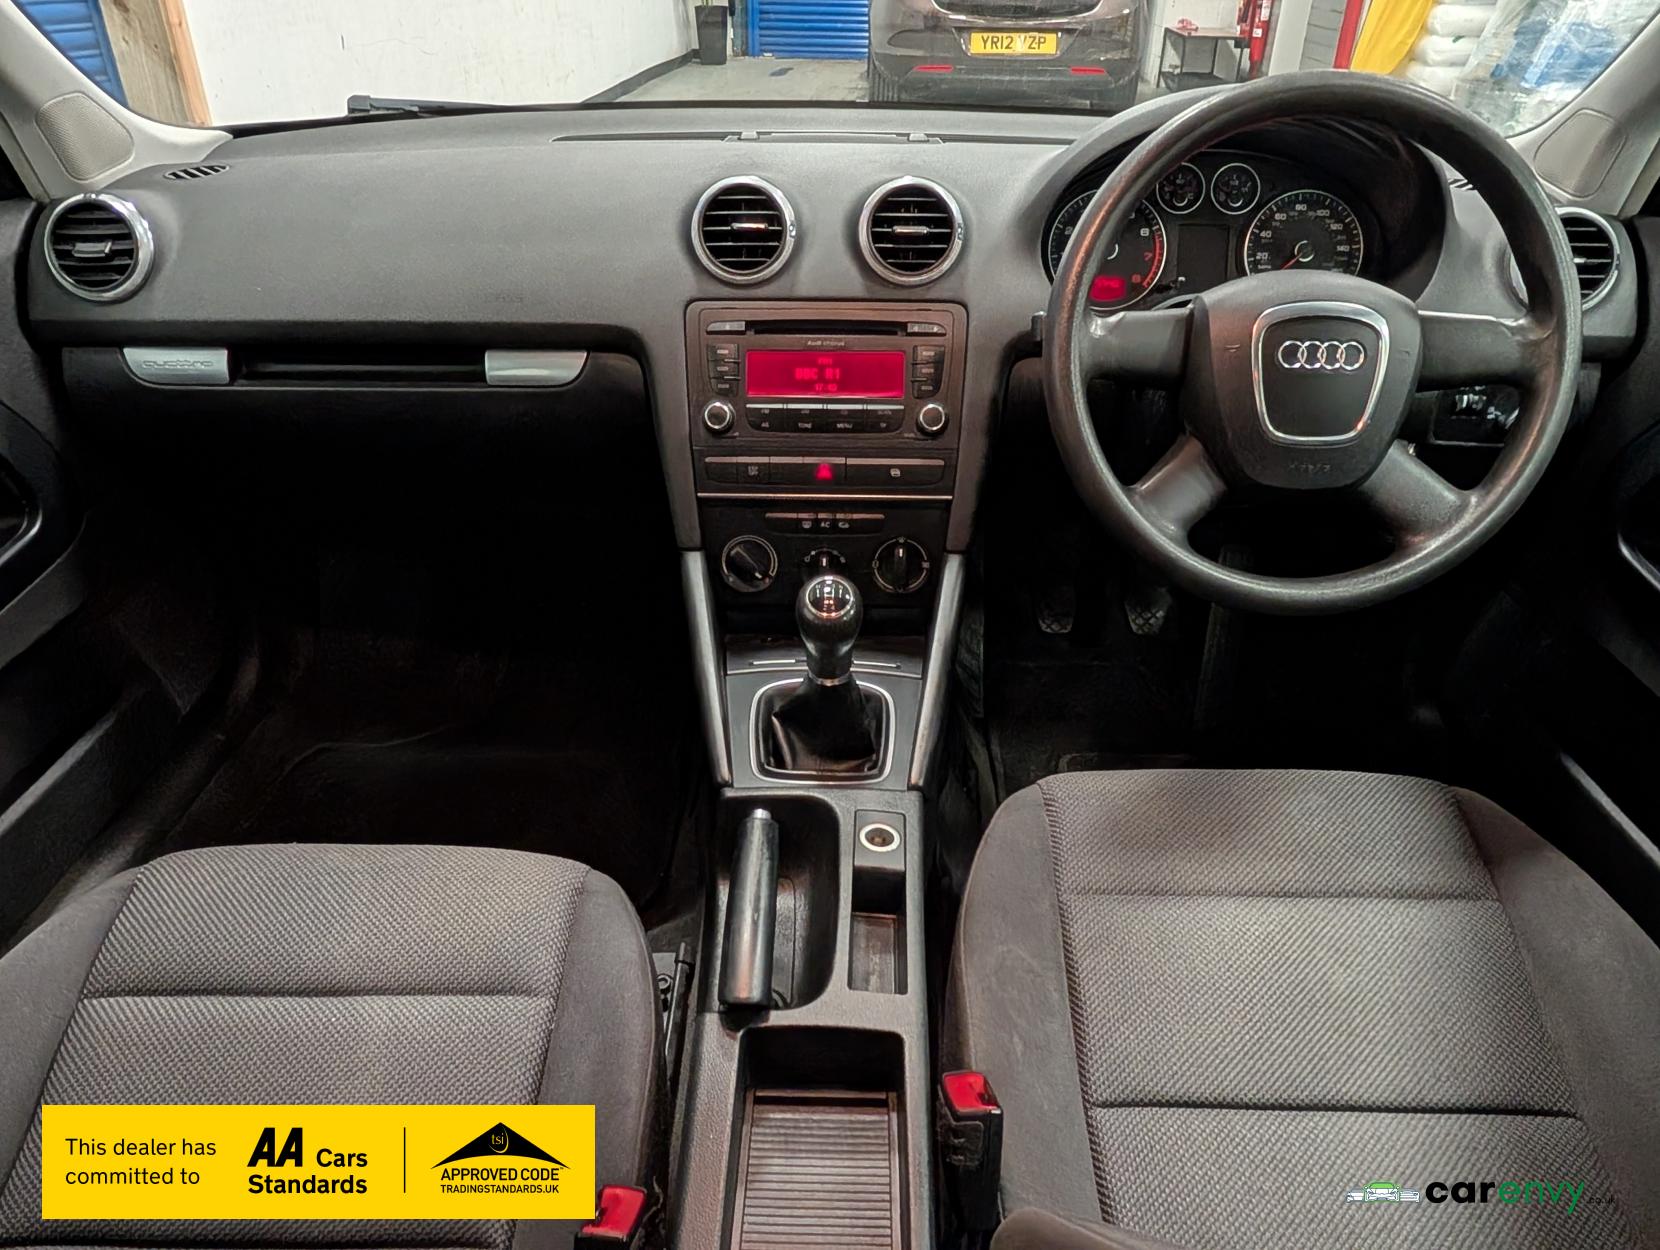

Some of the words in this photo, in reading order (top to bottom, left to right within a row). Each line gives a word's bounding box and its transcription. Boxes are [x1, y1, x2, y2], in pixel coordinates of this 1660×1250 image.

[981, 35, 1014, 50] YR12
[1260, 230, 1272, 238] 40
[1256, 252, 1268, 260] 20
